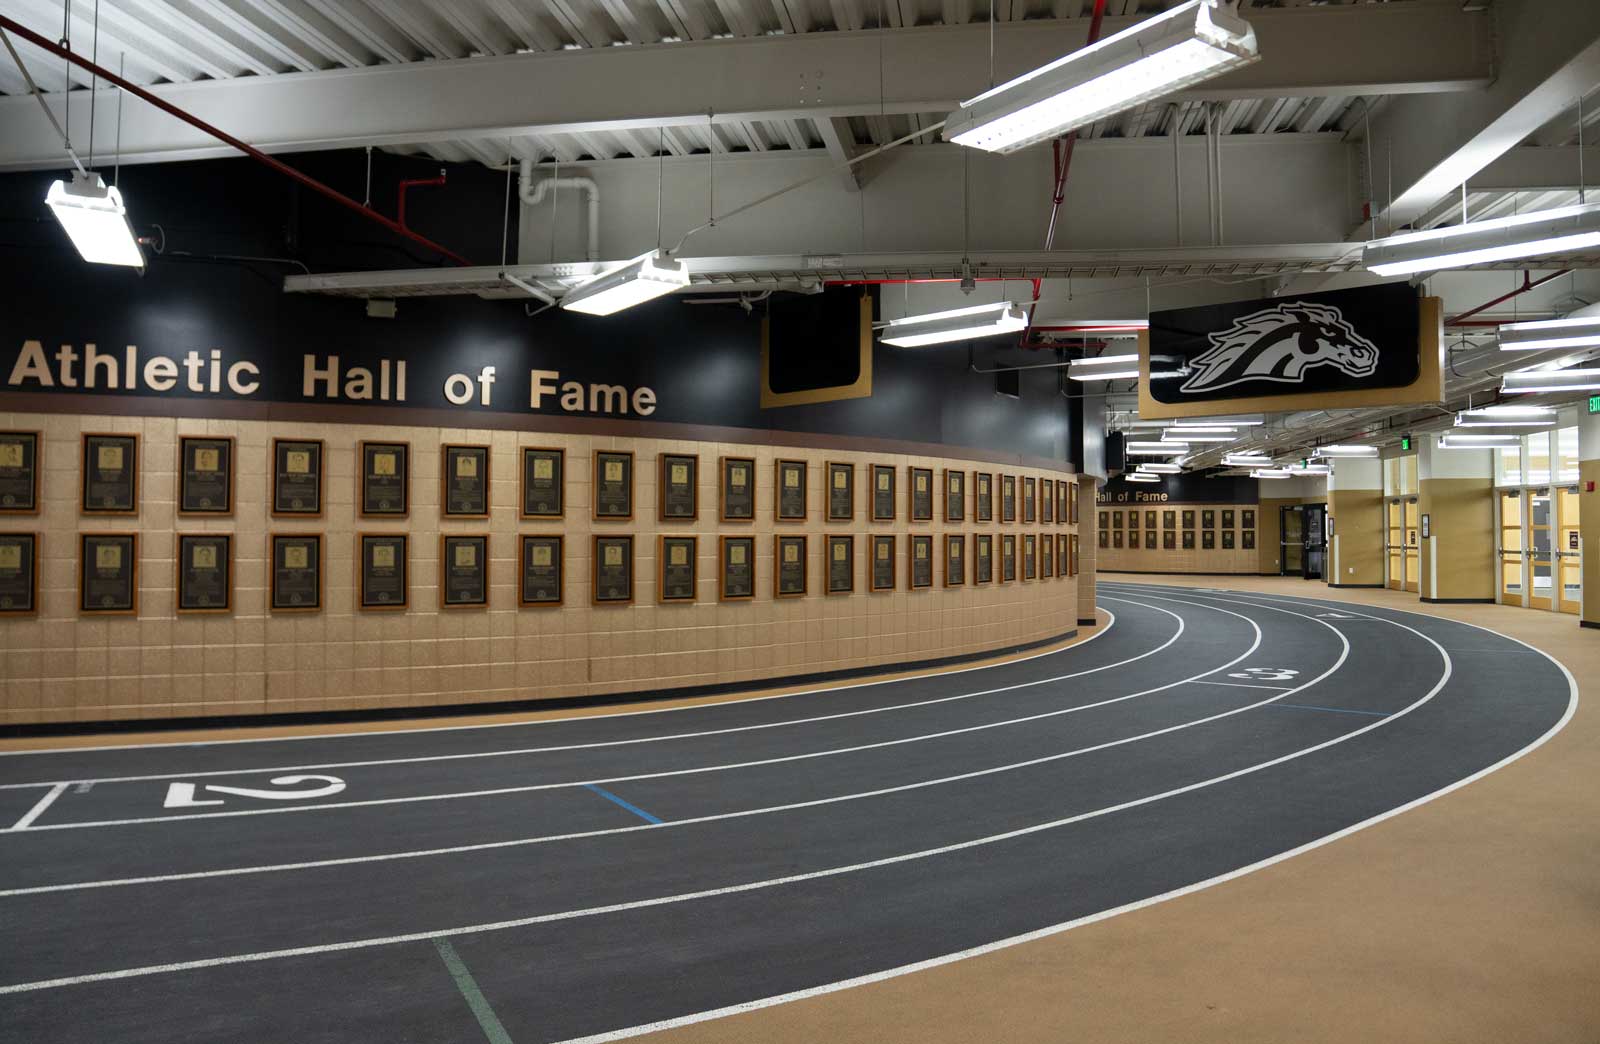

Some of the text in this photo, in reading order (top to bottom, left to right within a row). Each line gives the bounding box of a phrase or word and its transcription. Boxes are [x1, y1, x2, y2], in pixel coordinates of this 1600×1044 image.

[8, 340, 657, 416] Athletic Hall of Fame
[1118, 491, 1128, 502] of
[1136, 491, 1168, 502] Fame
[163, 774, 346, 808] 2
